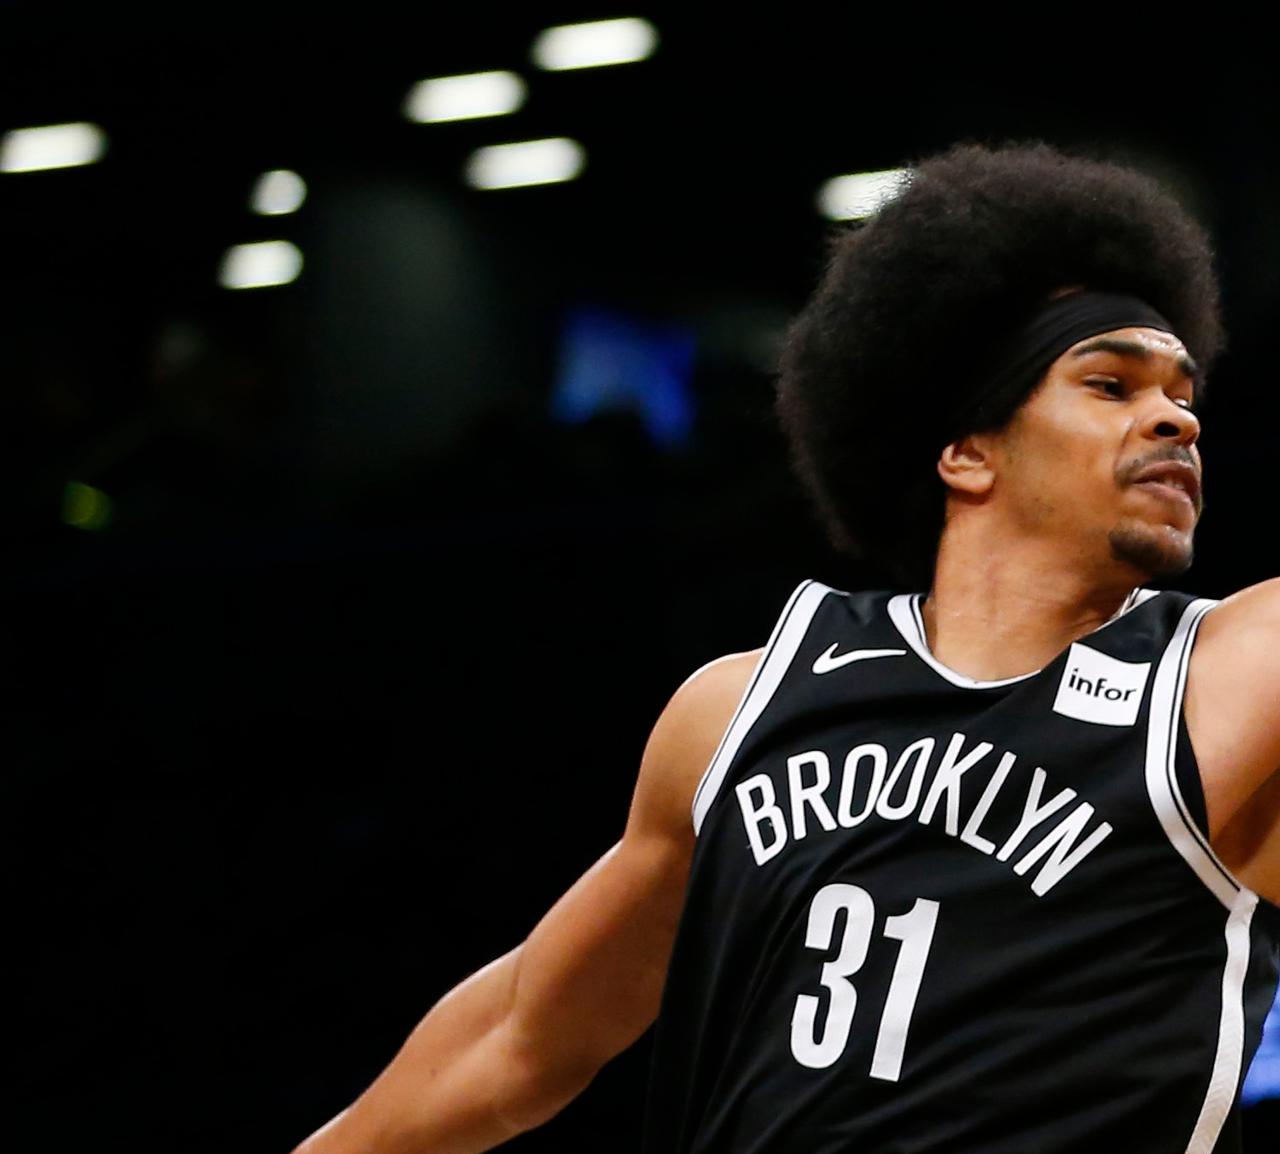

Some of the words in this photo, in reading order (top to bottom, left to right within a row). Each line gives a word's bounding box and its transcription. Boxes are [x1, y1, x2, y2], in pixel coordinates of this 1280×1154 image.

[1067, 666, 1138, 703] infor
[735, 731, 1114, 897] BROOKLYN
[790, 883, 940, 1083] 31
